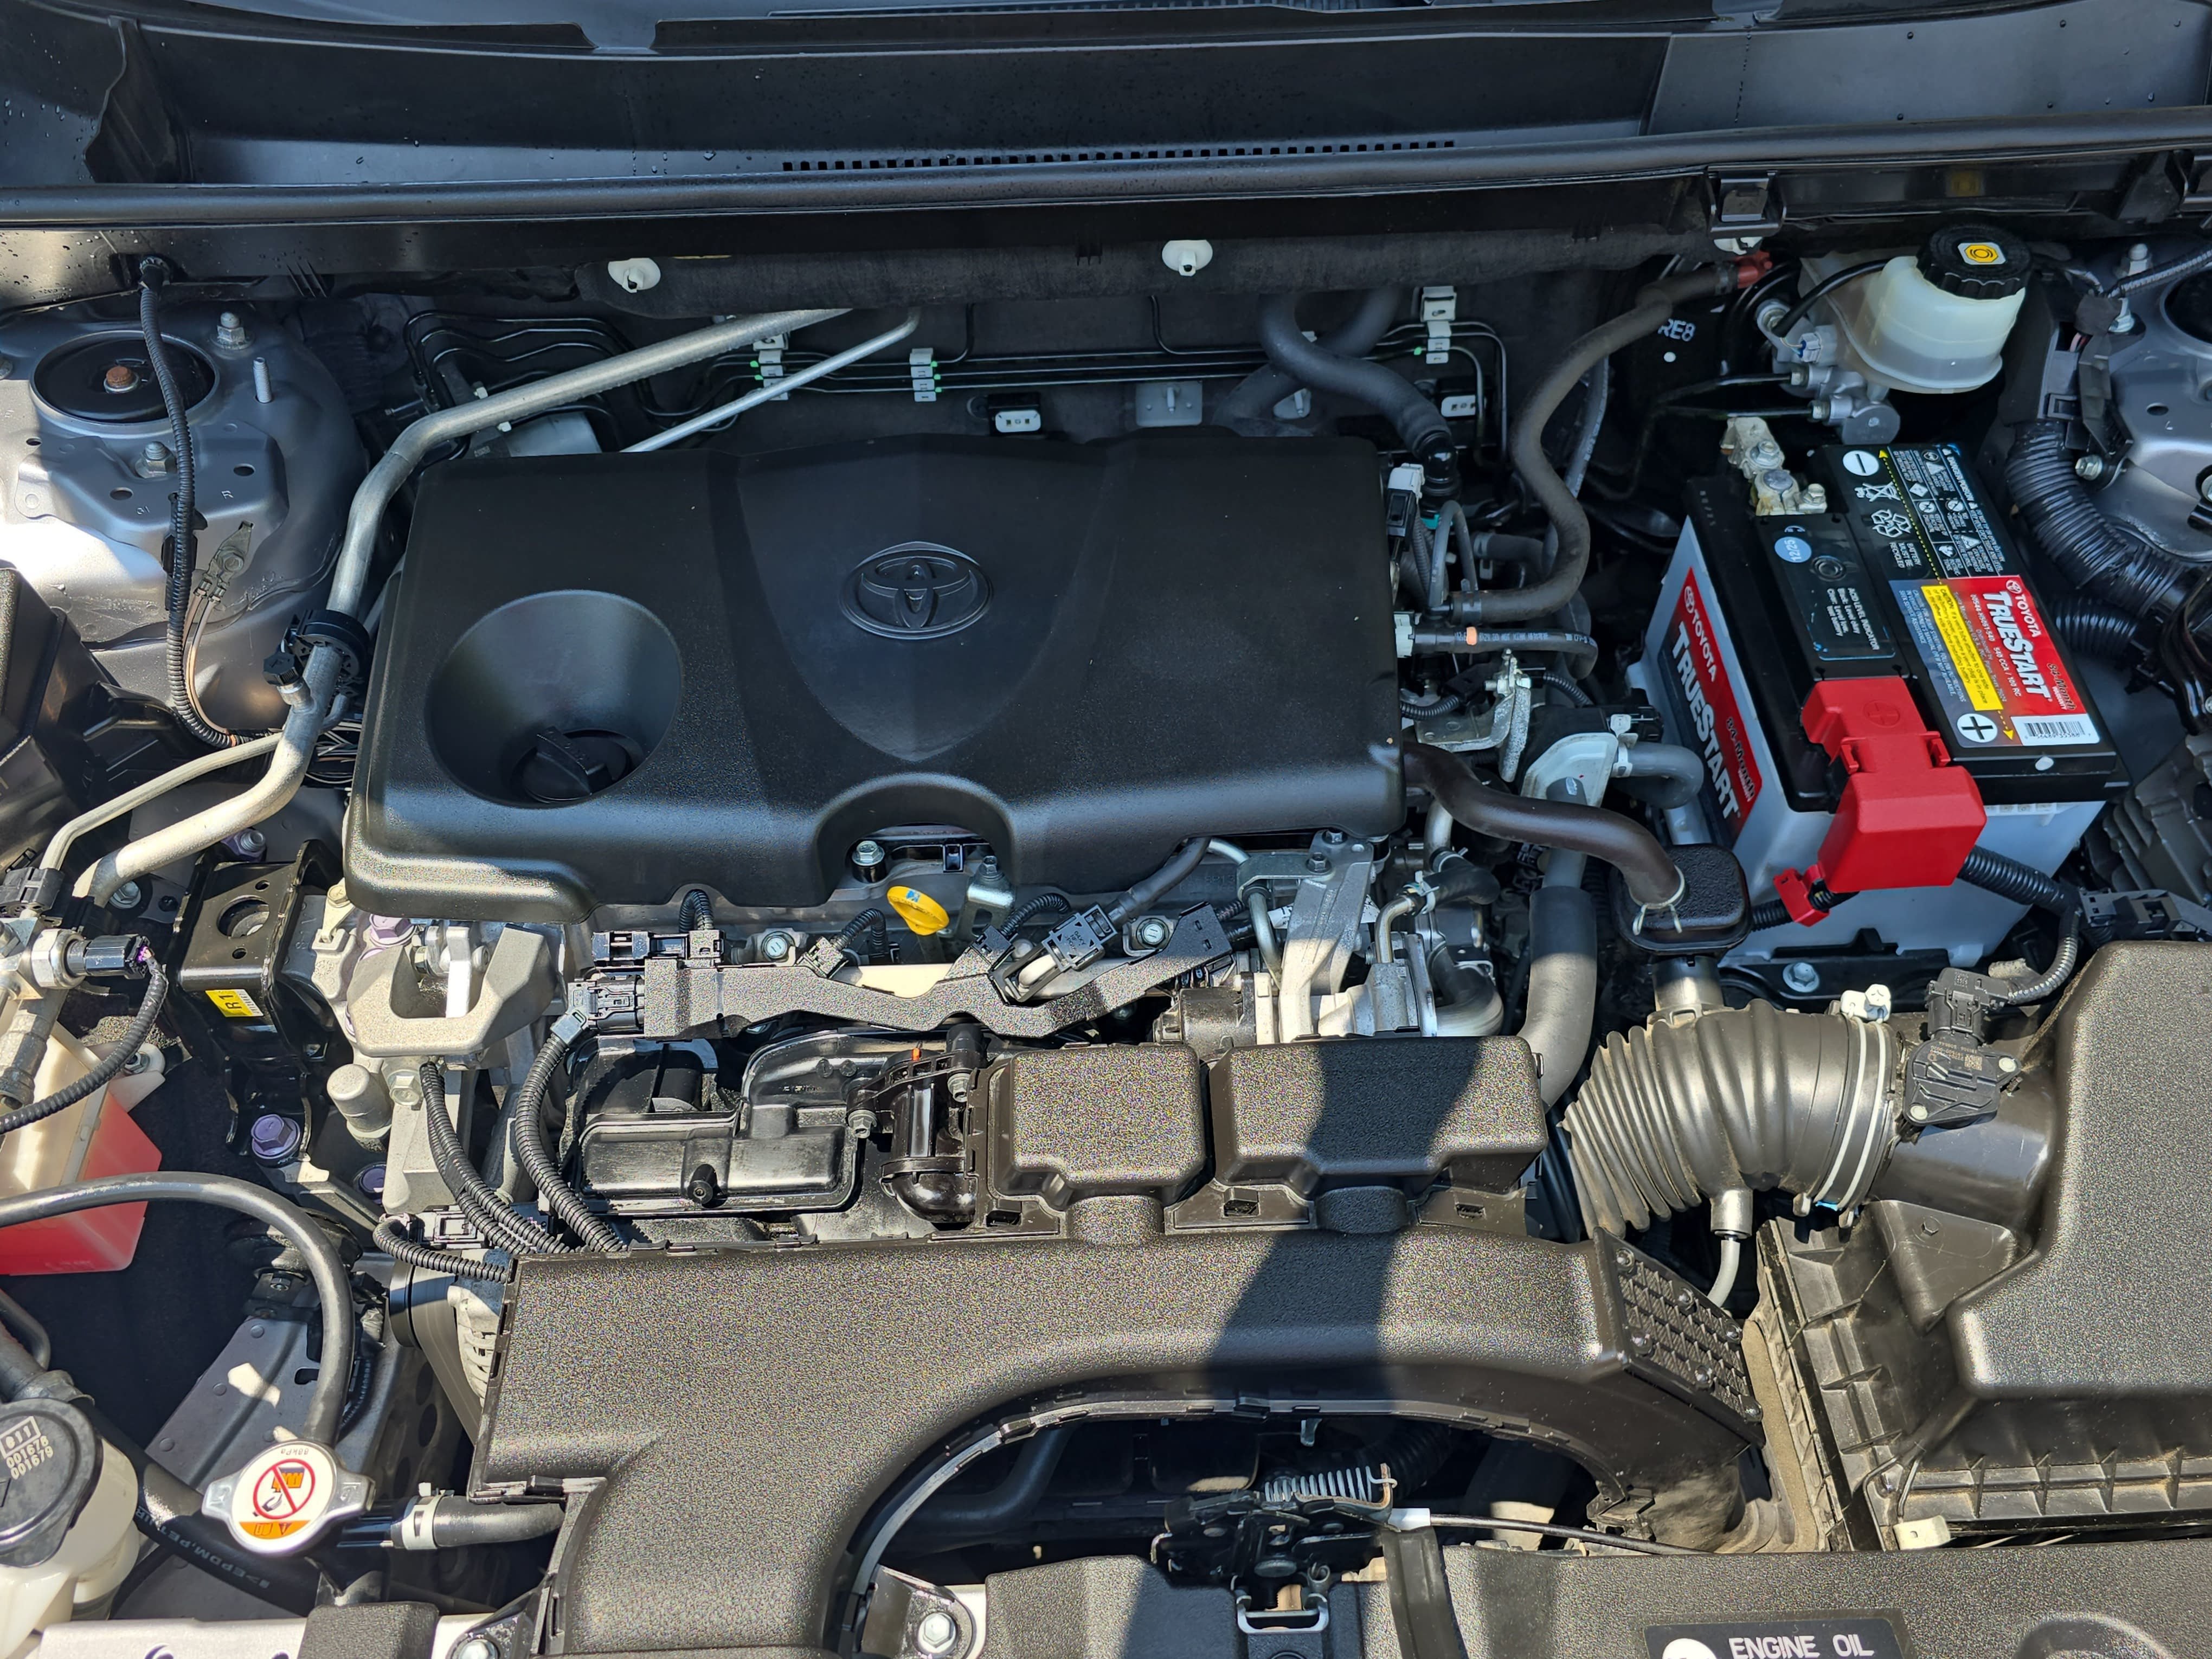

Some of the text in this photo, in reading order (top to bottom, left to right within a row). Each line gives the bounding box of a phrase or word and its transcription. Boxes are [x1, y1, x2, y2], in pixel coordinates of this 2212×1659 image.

[1784, 539, 1801, 561] 12/25
[1888, 542, 1906, 568] RECYCLED
[1897, 542, 1911, 558] MUST
[1906, 543, 1922, 565] BATTERY
[1847, 588, 1880, 650] ACID LEVEL INDICATOR
[2014, 594, 2042, 637] TOYOTA
[1692, 613, 1718, 682] TOYOTA
[1982, 591, 2053, 697] TRUESTART
[1993, 647, 2003, 657] 540
[1998, 659, 2009, 670] CCA
[2046, 664, 2078, 710] 84-Month
[1671, 618, 1739, 820] TRUESTART
[218, 994, 242, 1009] R1
[280, 1448, 309, 1456] 88kPa
[1728, 1634, 1875, 1659] ENGINE OIL
